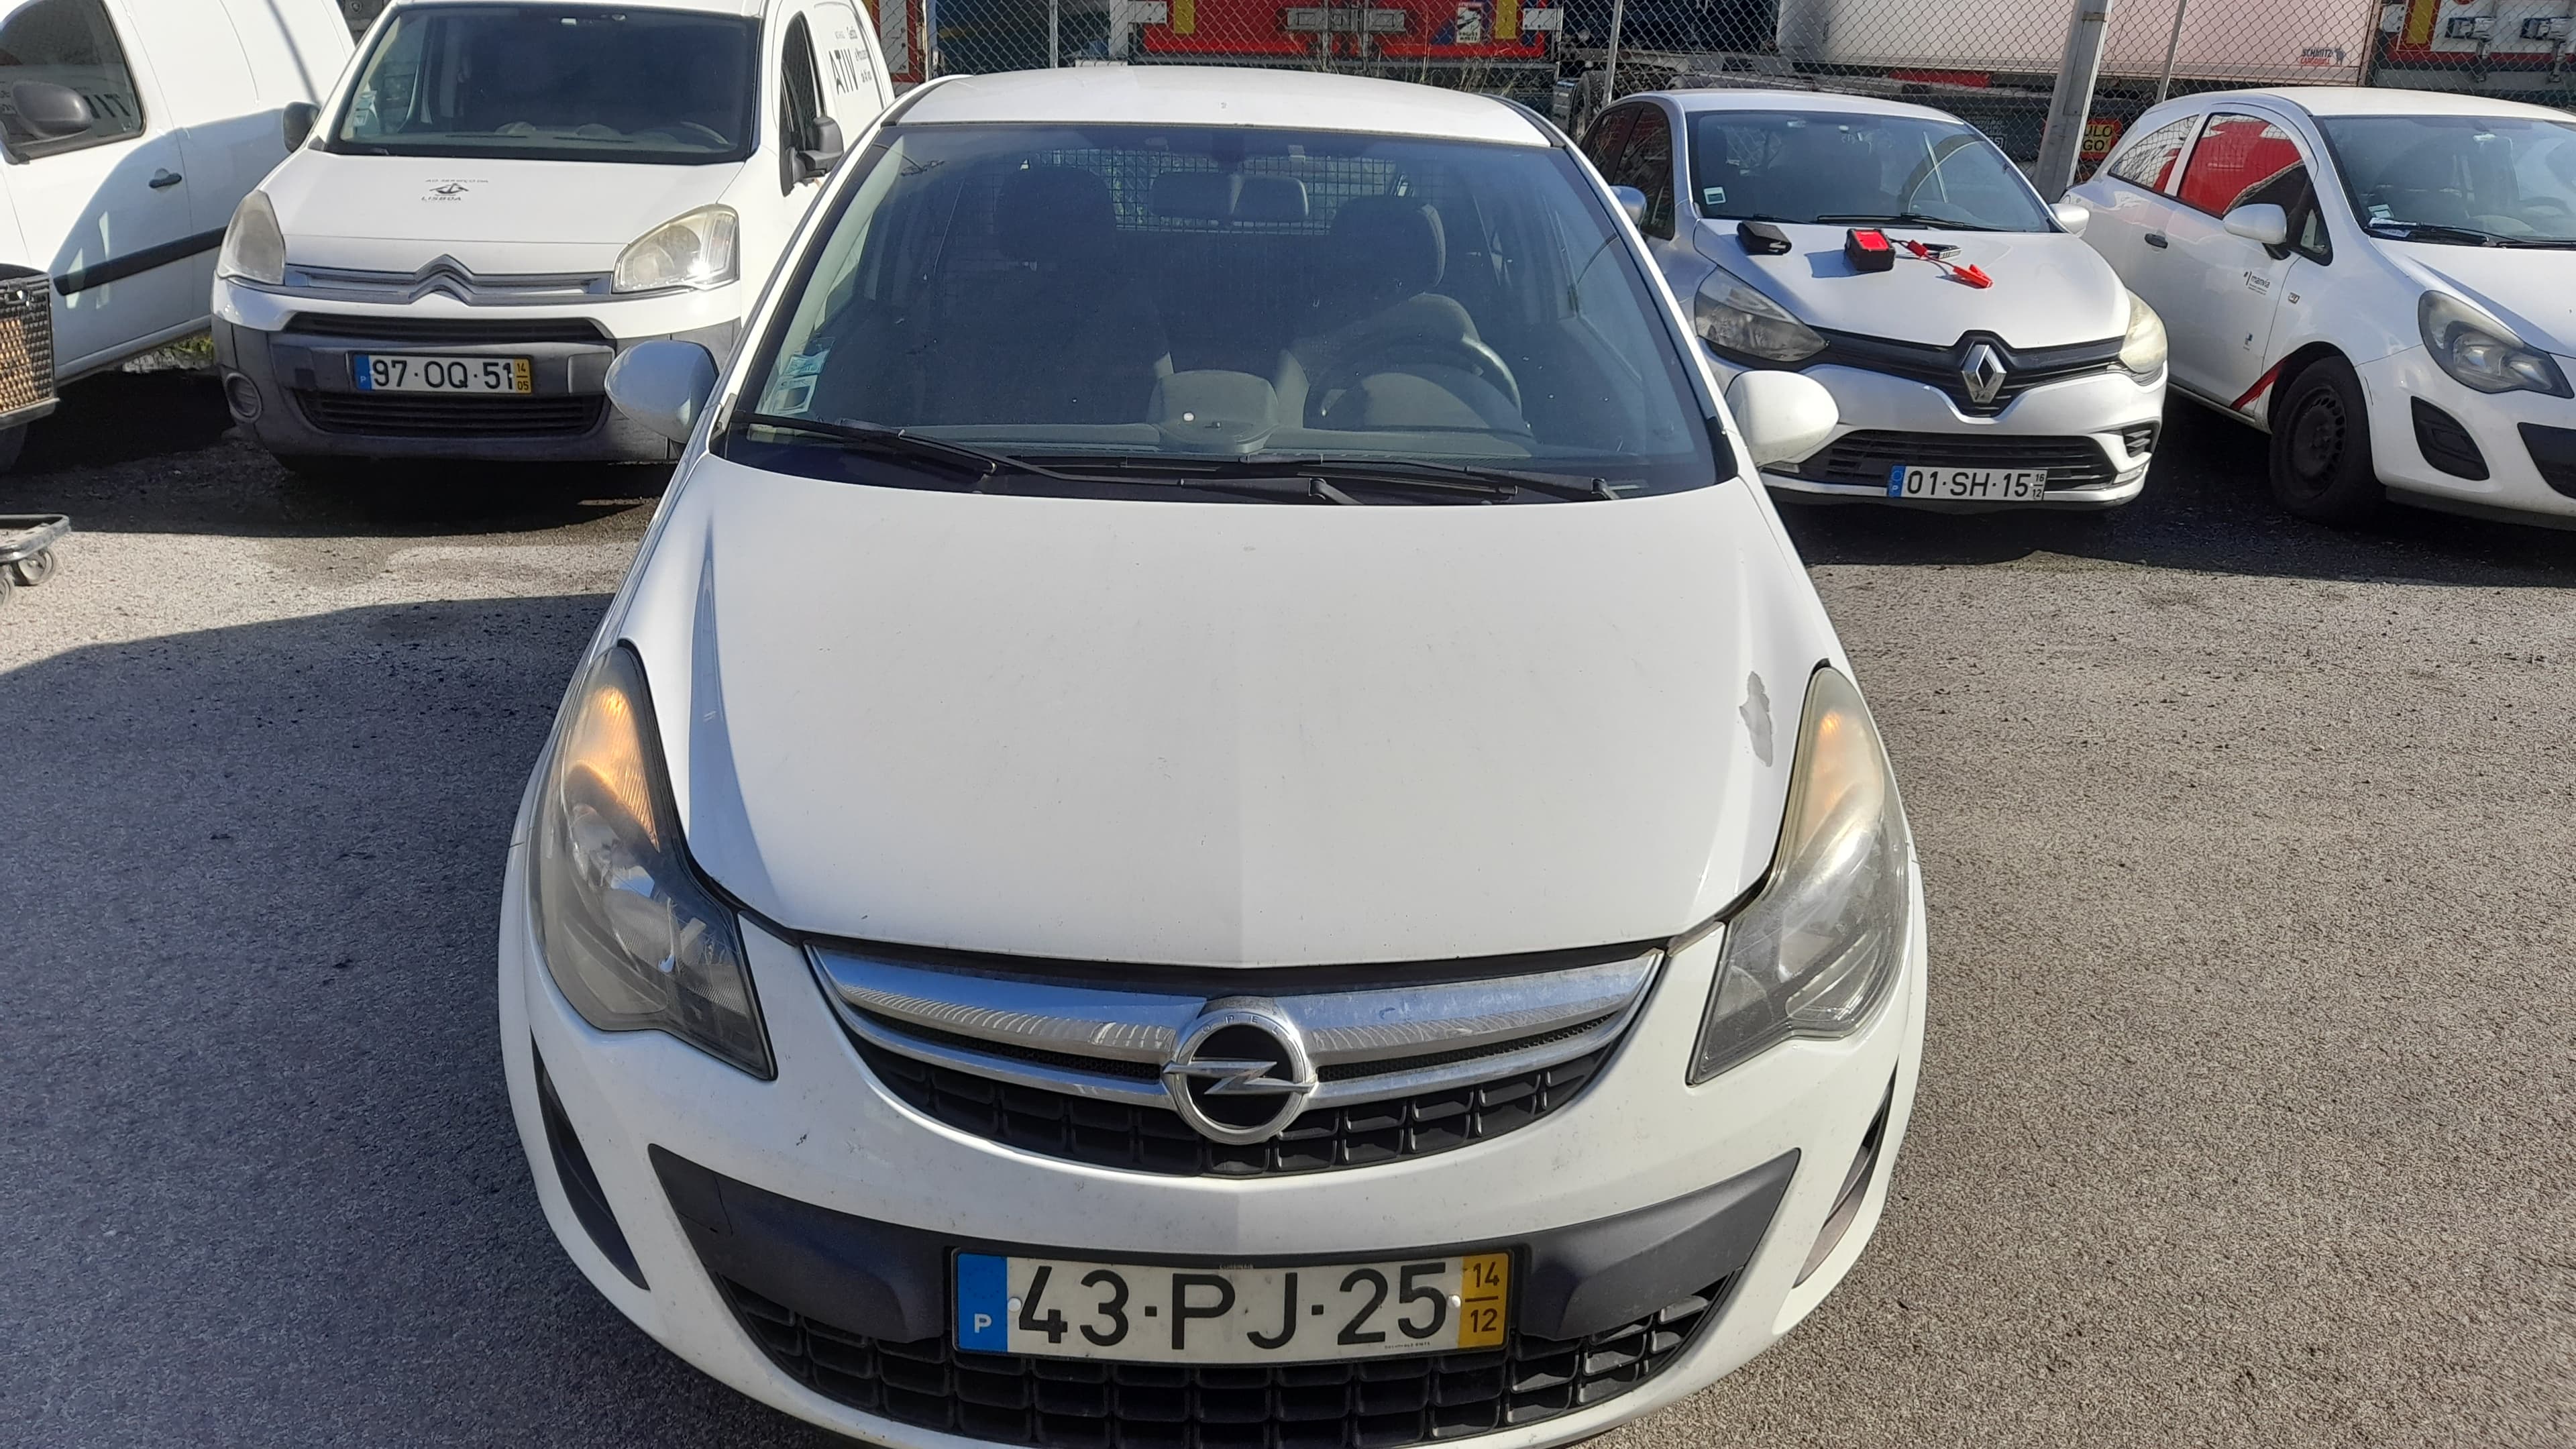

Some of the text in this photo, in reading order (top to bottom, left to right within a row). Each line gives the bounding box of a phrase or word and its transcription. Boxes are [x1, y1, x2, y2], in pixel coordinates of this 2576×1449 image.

[2302, 49, 2332, 58] SCHMITZ
[2083, 140, 2104, 151] GO
[517, 362, 527, 372] 14
[517, 381, 529, 390] 05
[2035, 474, 2045, 482] 16
[2033, 488, 2041, 498] 12
[1201, 1015, 1280, 1035] OPEL
[1472, 1261, 1500, 1289] 14
[974, 1313, 992, 1334] P
[1470, 1308, 1498, 1333] 12
